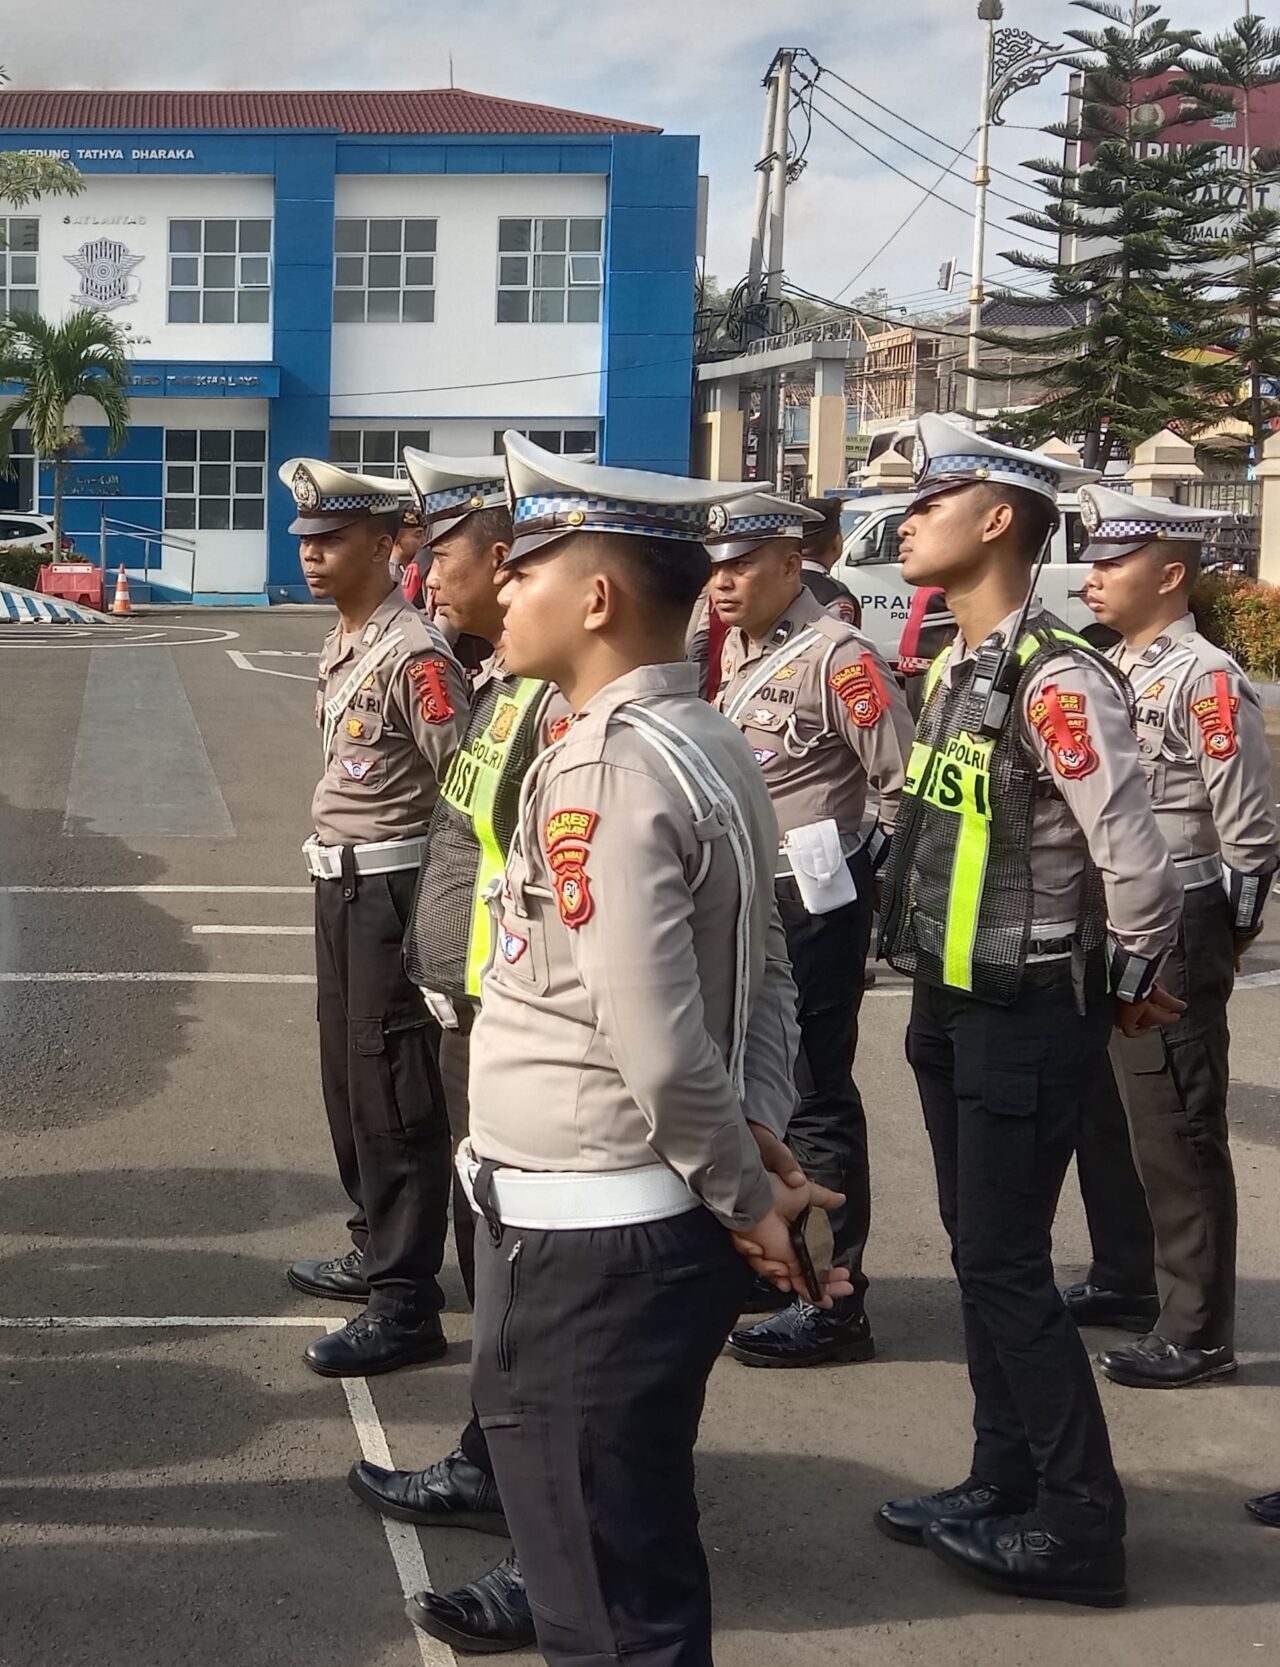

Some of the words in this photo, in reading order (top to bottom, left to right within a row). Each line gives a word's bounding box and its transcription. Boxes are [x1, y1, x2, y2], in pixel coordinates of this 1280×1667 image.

[77, 149, 124, 160] TATHYA
[131, 149, 195, 160] DHARAKA
[62, 215, 147, 226] SATLANTAS
[1135, 706, 1165, 728] LRI
[471, 740, 504, 770] POLRI
[946, 741, 985, 771] POLRI
